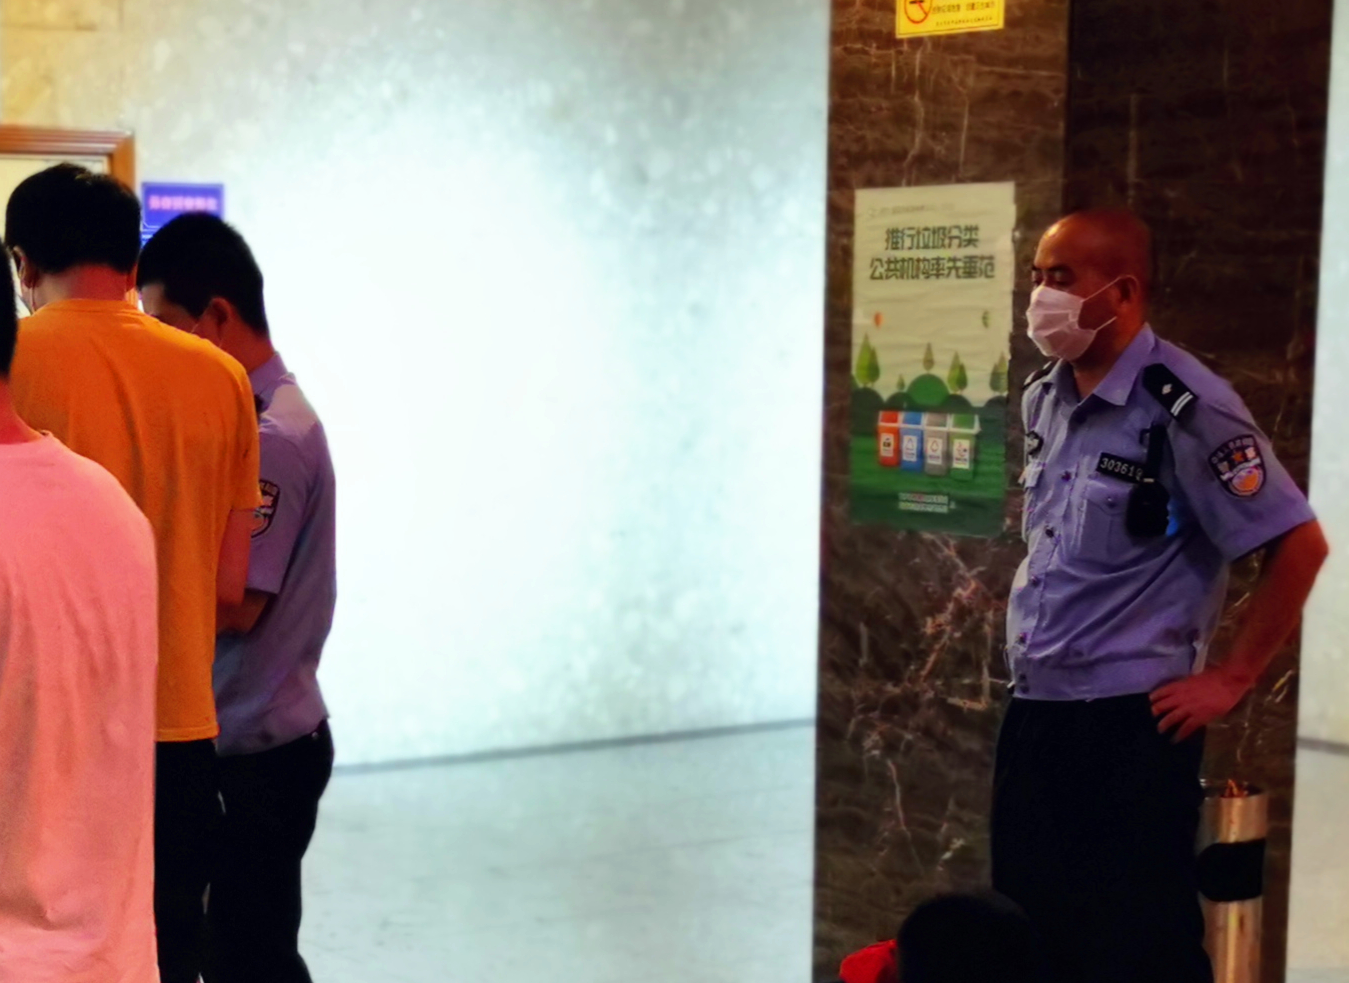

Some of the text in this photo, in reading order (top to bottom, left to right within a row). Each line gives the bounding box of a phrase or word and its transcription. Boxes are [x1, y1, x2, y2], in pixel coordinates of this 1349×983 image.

[885, 224, 980, 251] 推行垃圾分类
[869, 255, 996, 281] 公共机构率先垂范
